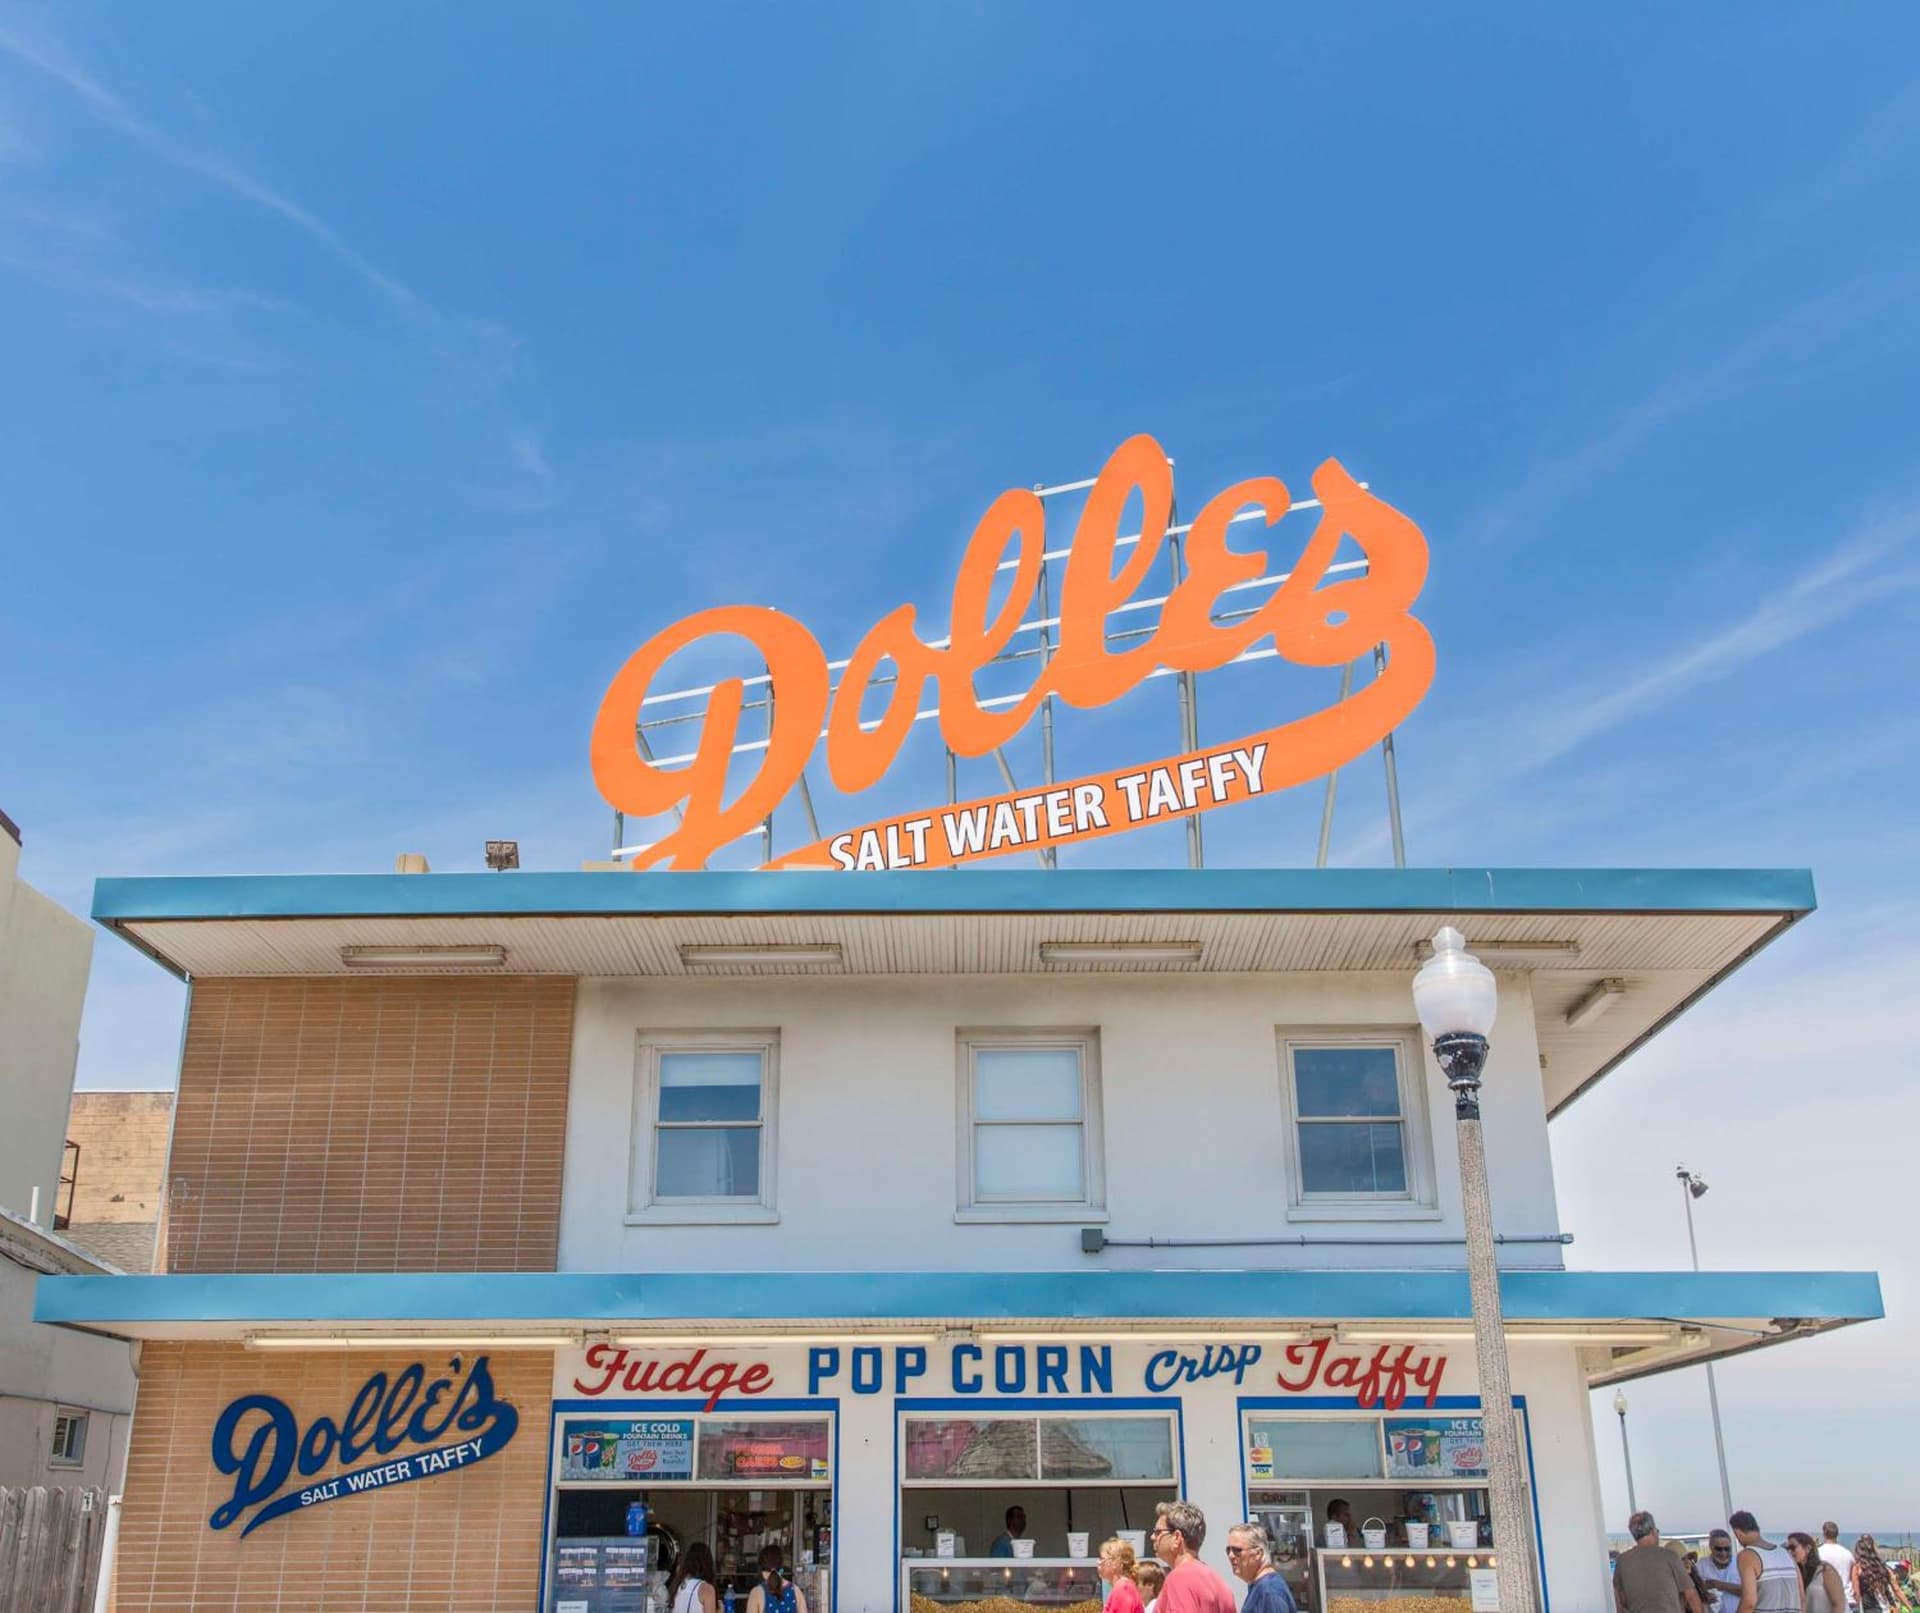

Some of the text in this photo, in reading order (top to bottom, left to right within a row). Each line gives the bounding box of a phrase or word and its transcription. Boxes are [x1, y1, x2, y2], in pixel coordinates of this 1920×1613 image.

[591, 434, 1436, 871] Dolles
[829, 742, 1268, 870] SALT WATER TAFFY
[574, 1344, 774, 1413] Fudge
[809, 1344, 1113, 1395] POP CORN
[1145, 1345, 1261, 1394] Crisp
[1278, 1338, 1447, 1411] Taffy
[209, 1356, 519, 1530] Dolle's
[631, 1423, 680, 1433] ICE COLD
[1451, 1420, 1468, 1430] ICE
[300, 1439, 484, 1506] SALT WATER TAFFY
